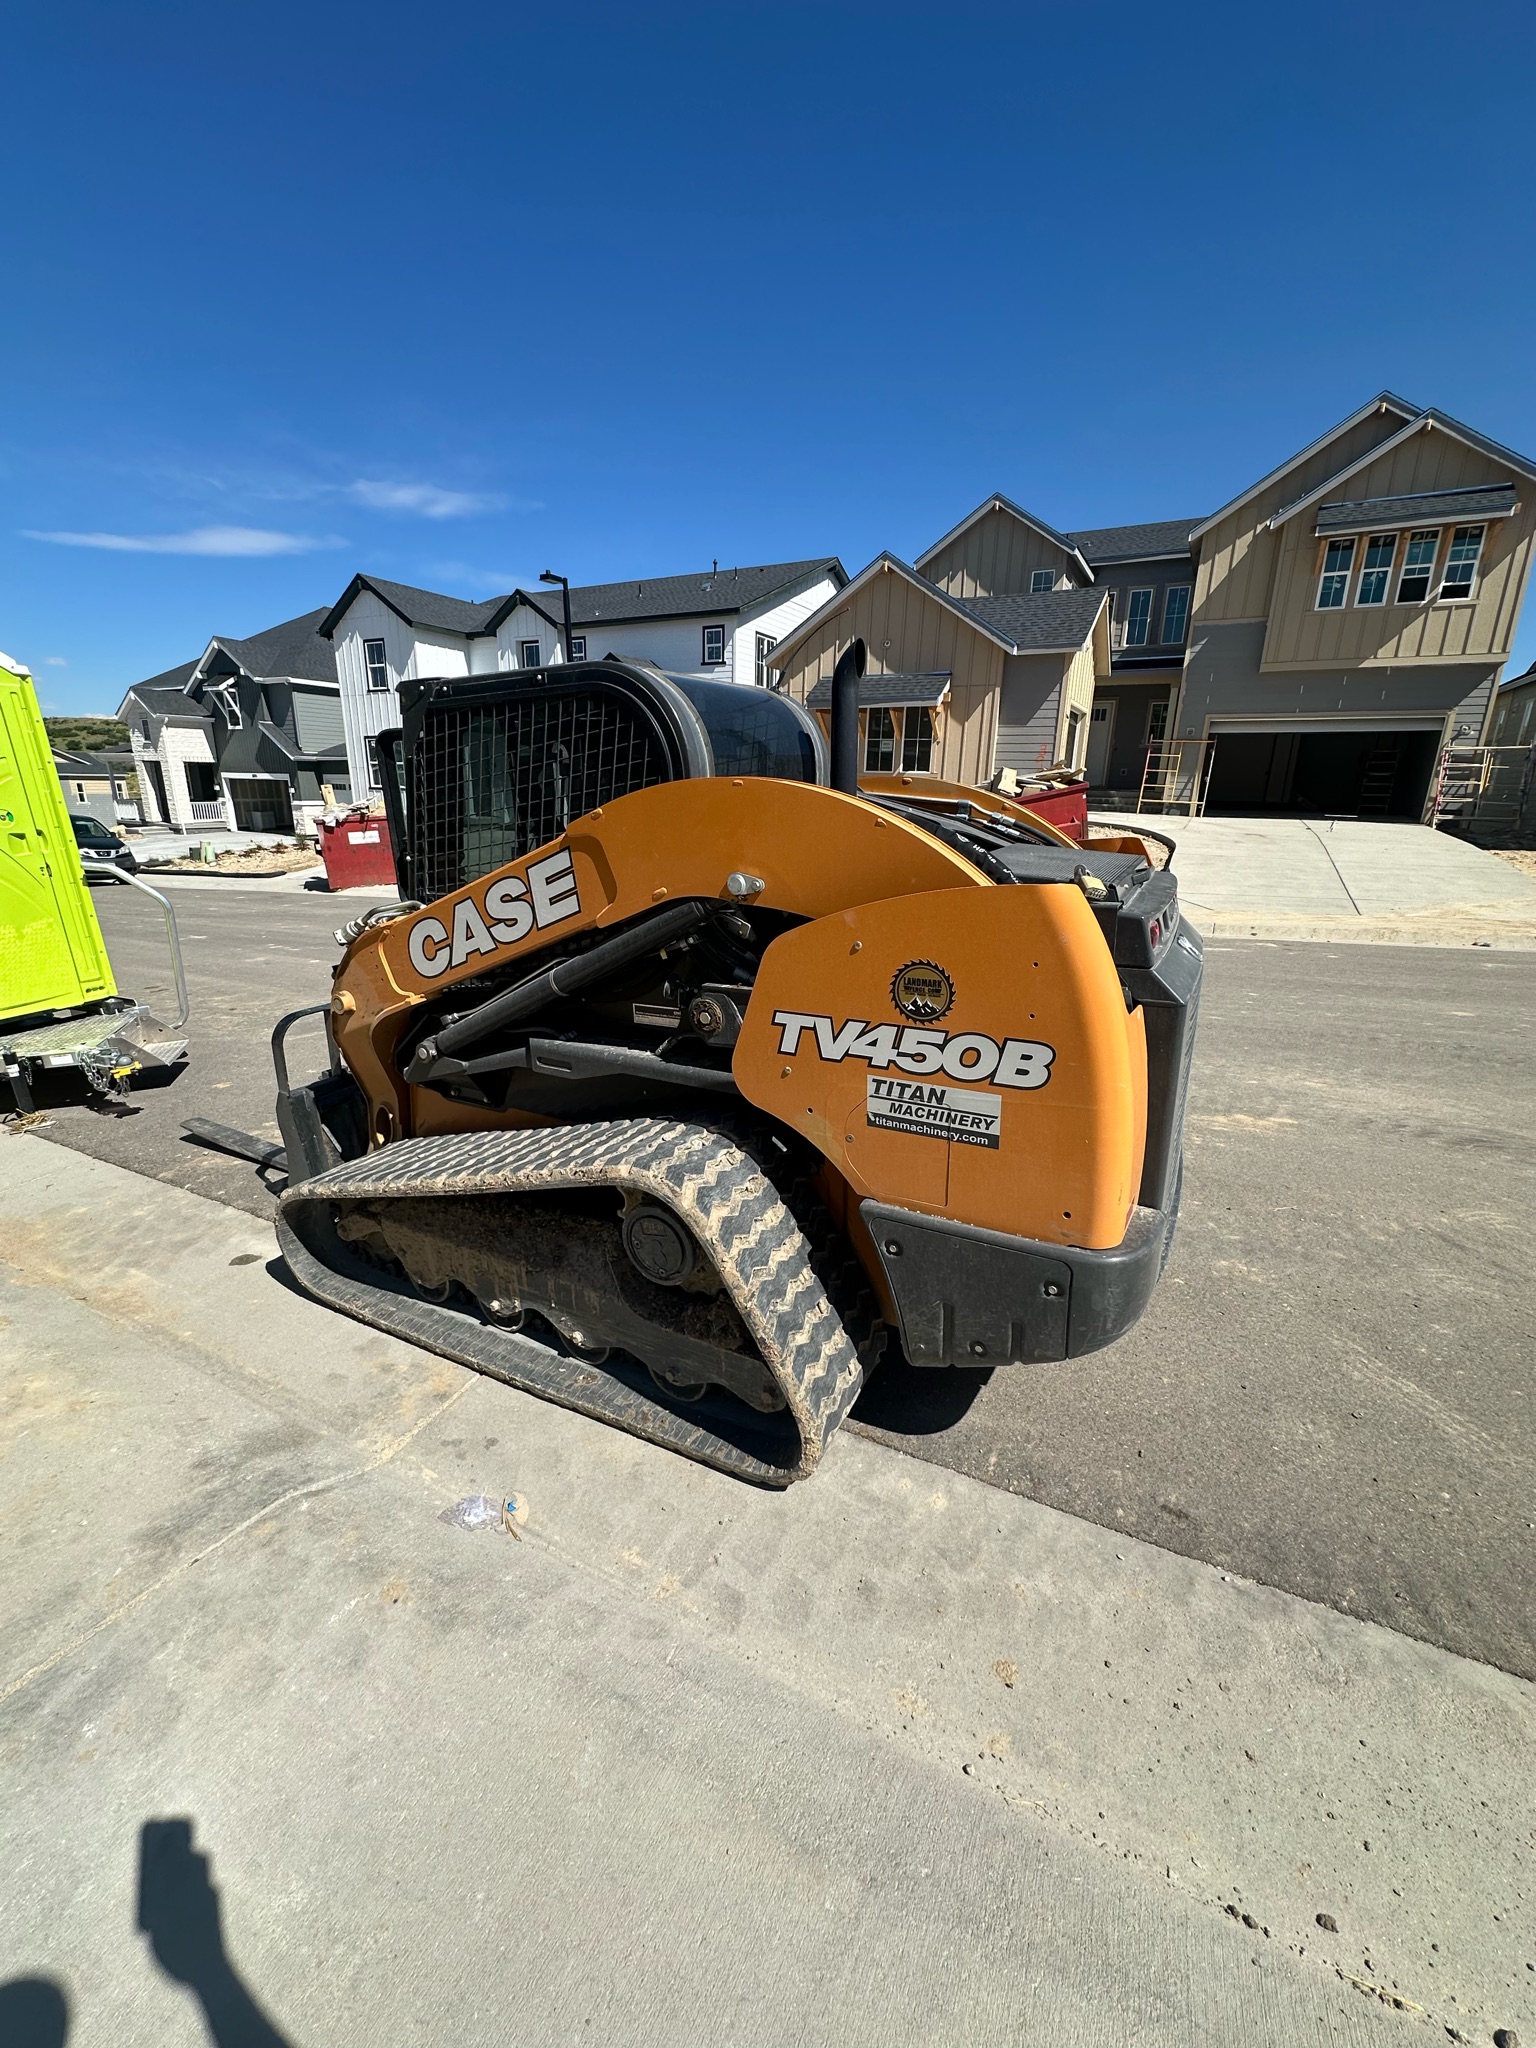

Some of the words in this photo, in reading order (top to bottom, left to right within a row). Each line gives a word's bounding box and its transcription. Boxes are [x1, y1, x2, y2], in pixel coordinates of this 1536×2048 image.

[407, 846, 581, 979] CASE
[903, 977, 942, 988] LANDMARK
[771, 1010, 1056, 1090] TV450B
[871, 1078, 947, 1105] TITAN
[875, 1115, 989, 1145] titanmachinery.com
[889, 1102, 996, 1131] MACHINERY
